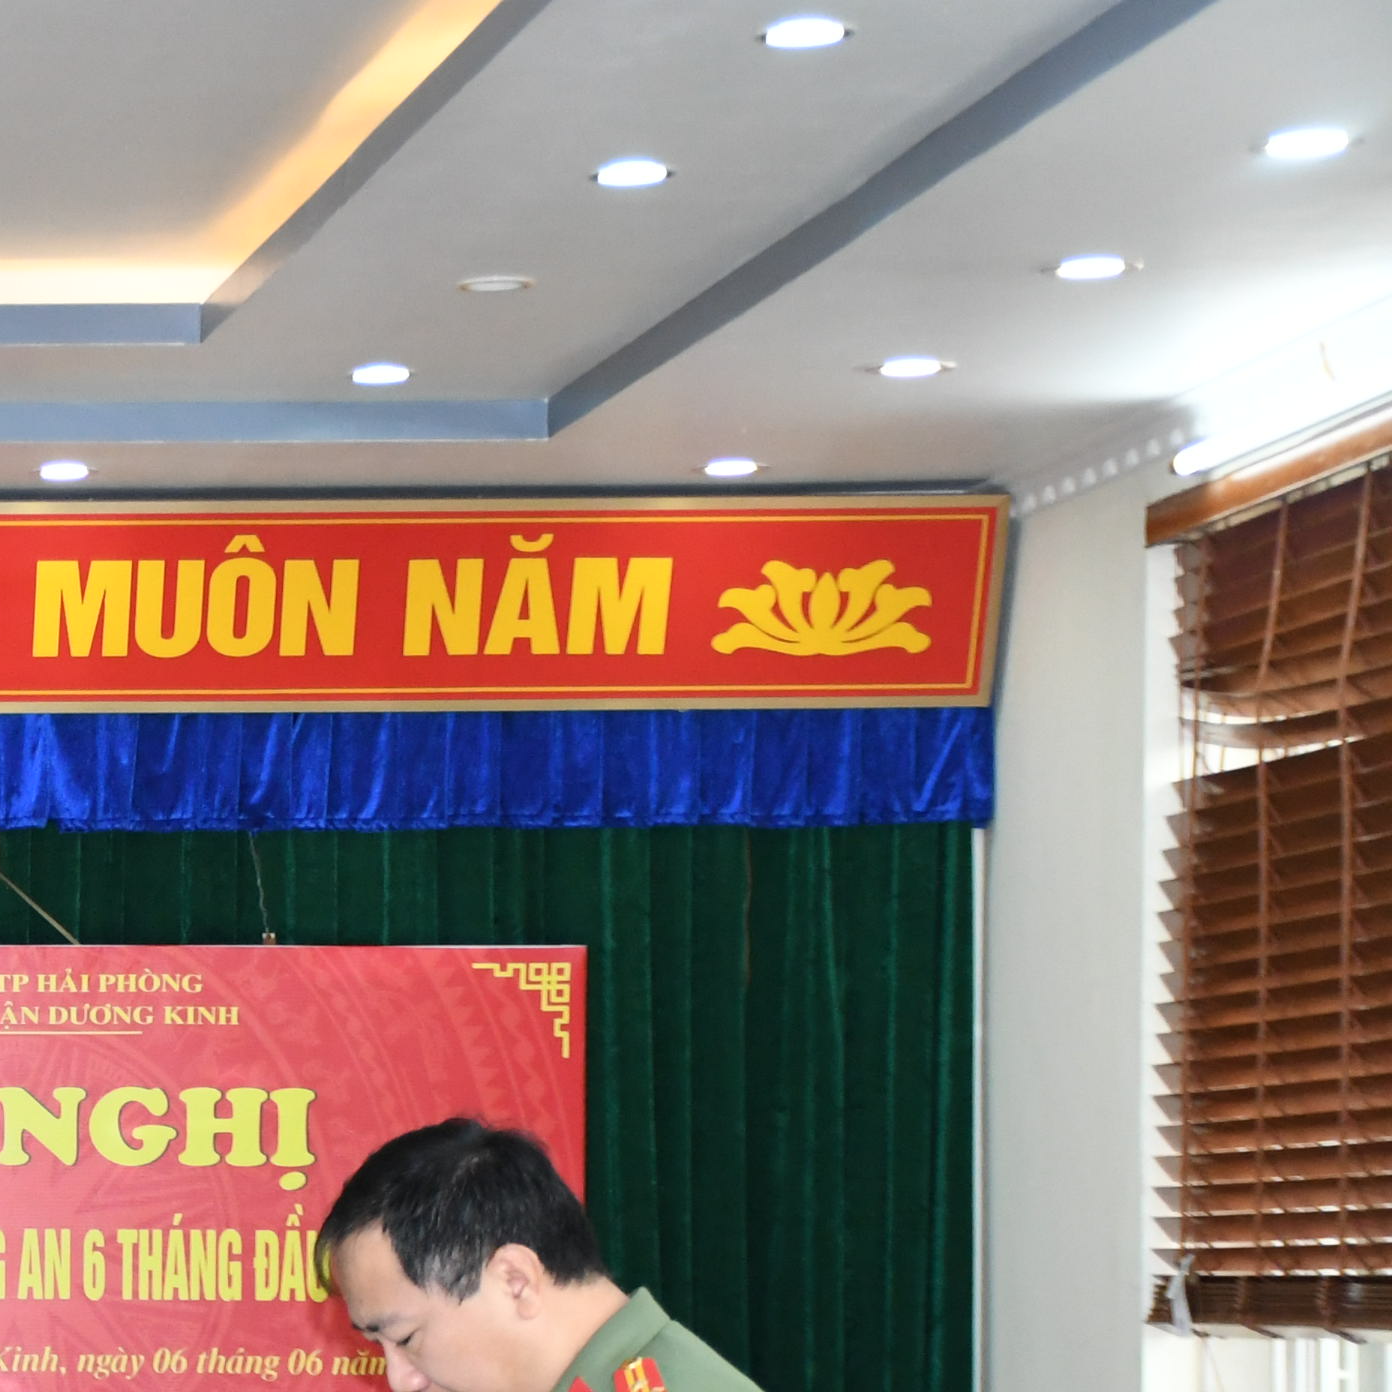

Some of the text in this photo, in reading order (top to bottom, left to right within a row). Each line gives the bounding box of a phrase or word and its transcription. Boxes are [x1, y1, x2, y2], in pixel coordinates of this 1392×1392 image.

[33, 535, 361, 657] MUÔN
[403, 535, 673, 656] NĂM
[37, 968, 88, 992] HẢI
[99, 969, 203, 993] PHÒNG
[49, 1004, 154, 1025] DƯƠNG
[164, 1007, 240, 1025] KINH
[18, 1229, 71, 1299] AN
[84, 1229, 105, 1300] 6
[117, 1214, 242, 1300] THÁNG
[254, 1204, 331, 1302] ĐẦU
[78, 1347, 144, 1378] ngày
[153, 1348, 187, 1373] 06
[197, 1347, 280, 1380] tháng
[288, 1349, 322, 1375] 06
